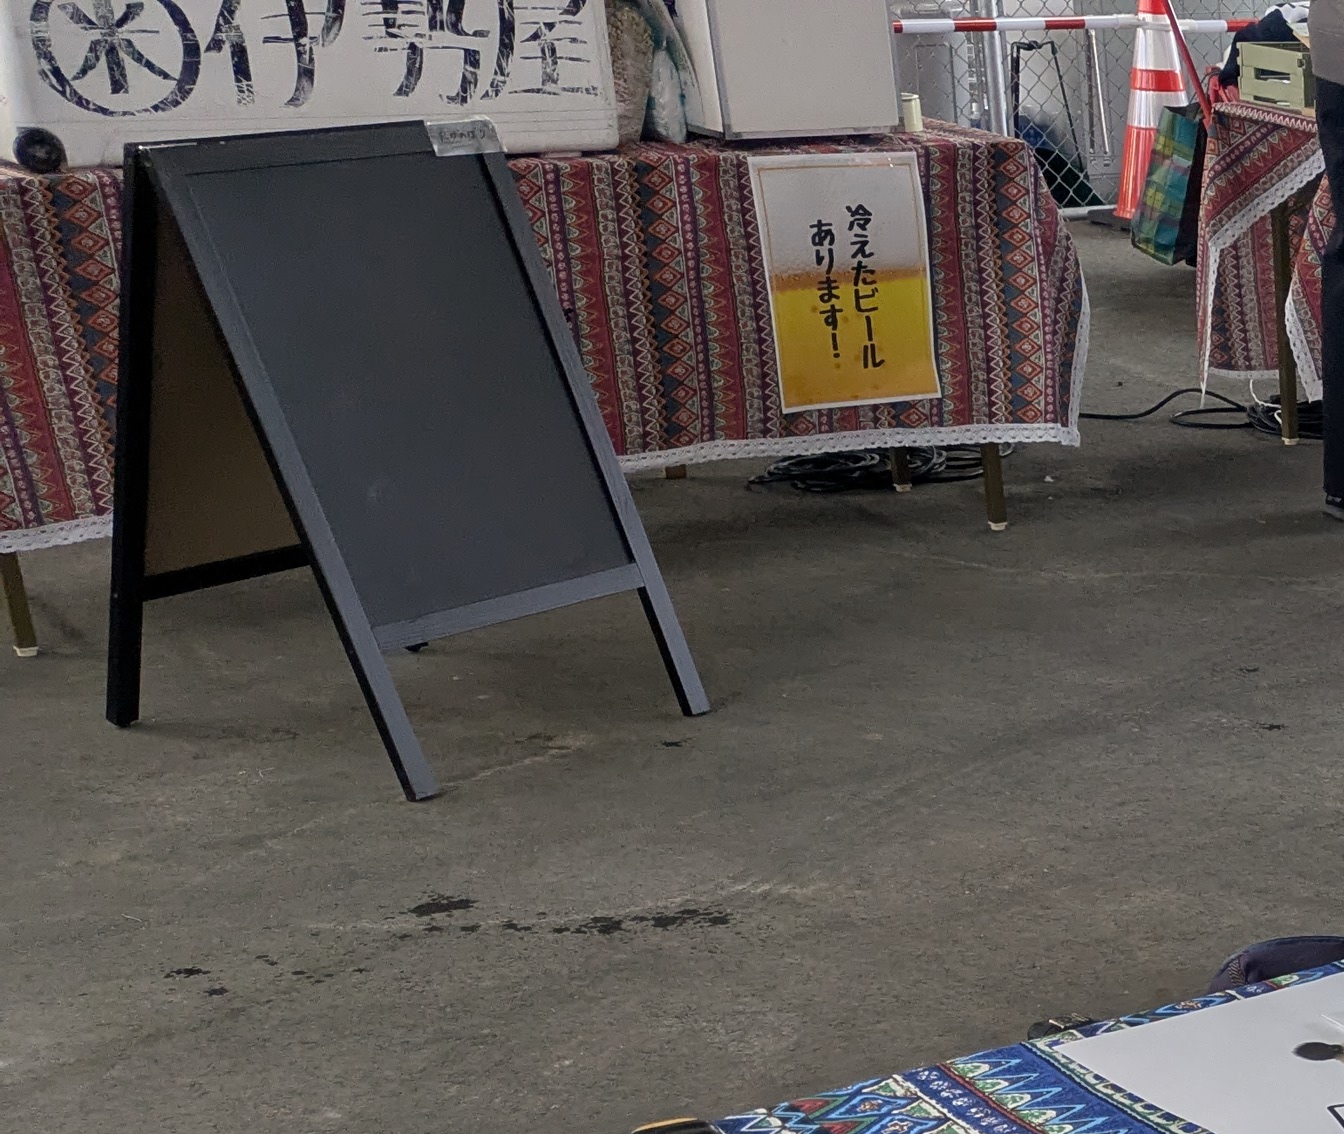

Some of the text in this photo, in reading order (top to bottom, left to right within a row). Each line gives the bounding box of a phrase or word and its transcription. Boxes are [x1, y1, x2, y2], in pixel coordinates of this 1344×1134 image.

[809, 219, 843, 359] あります!
[845, 203, 885, 369] 冷えたビール
